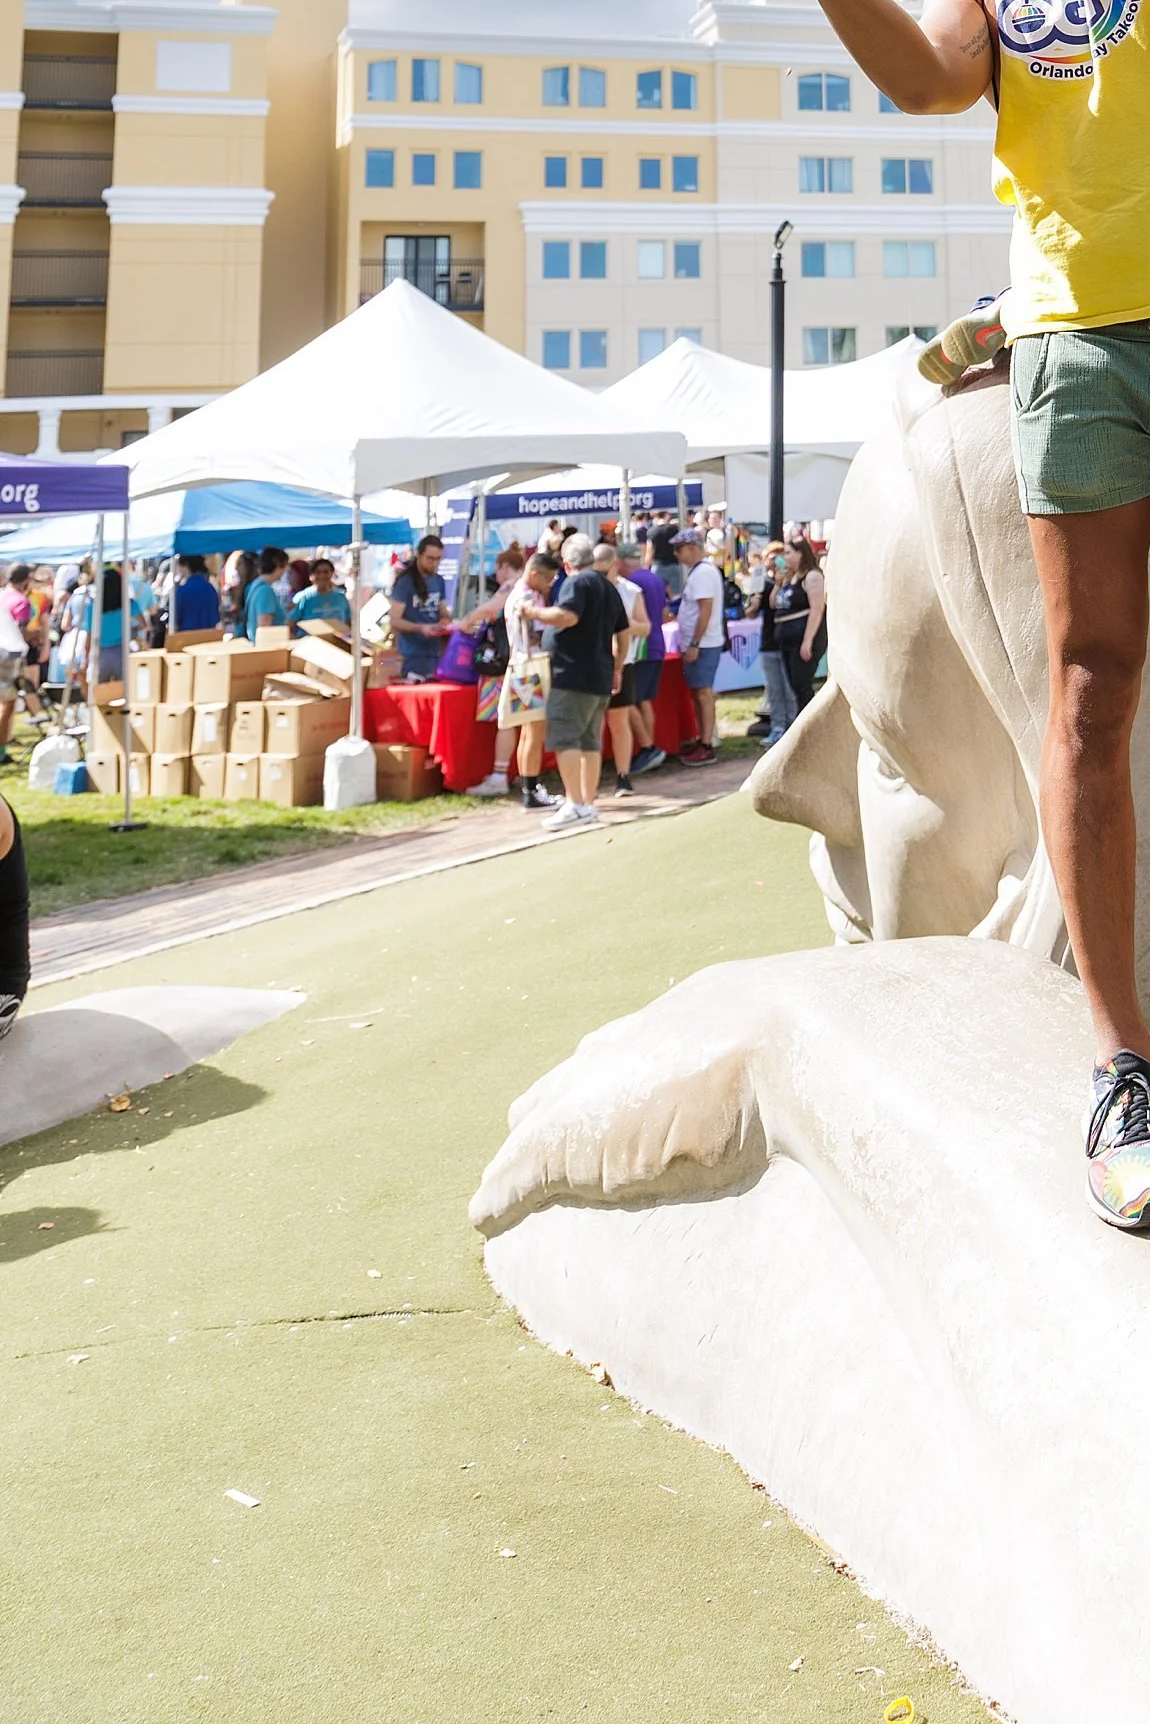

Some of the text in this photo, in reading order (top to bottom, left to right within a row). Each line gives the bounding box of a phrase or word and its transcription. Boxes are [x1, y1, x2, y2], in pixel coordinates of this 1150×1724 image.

[1030, 61, 1094, 78] Orlando
[1093, 42, 1108, 58] ay
[518, 490, 655, 516] hopeandhelporg
